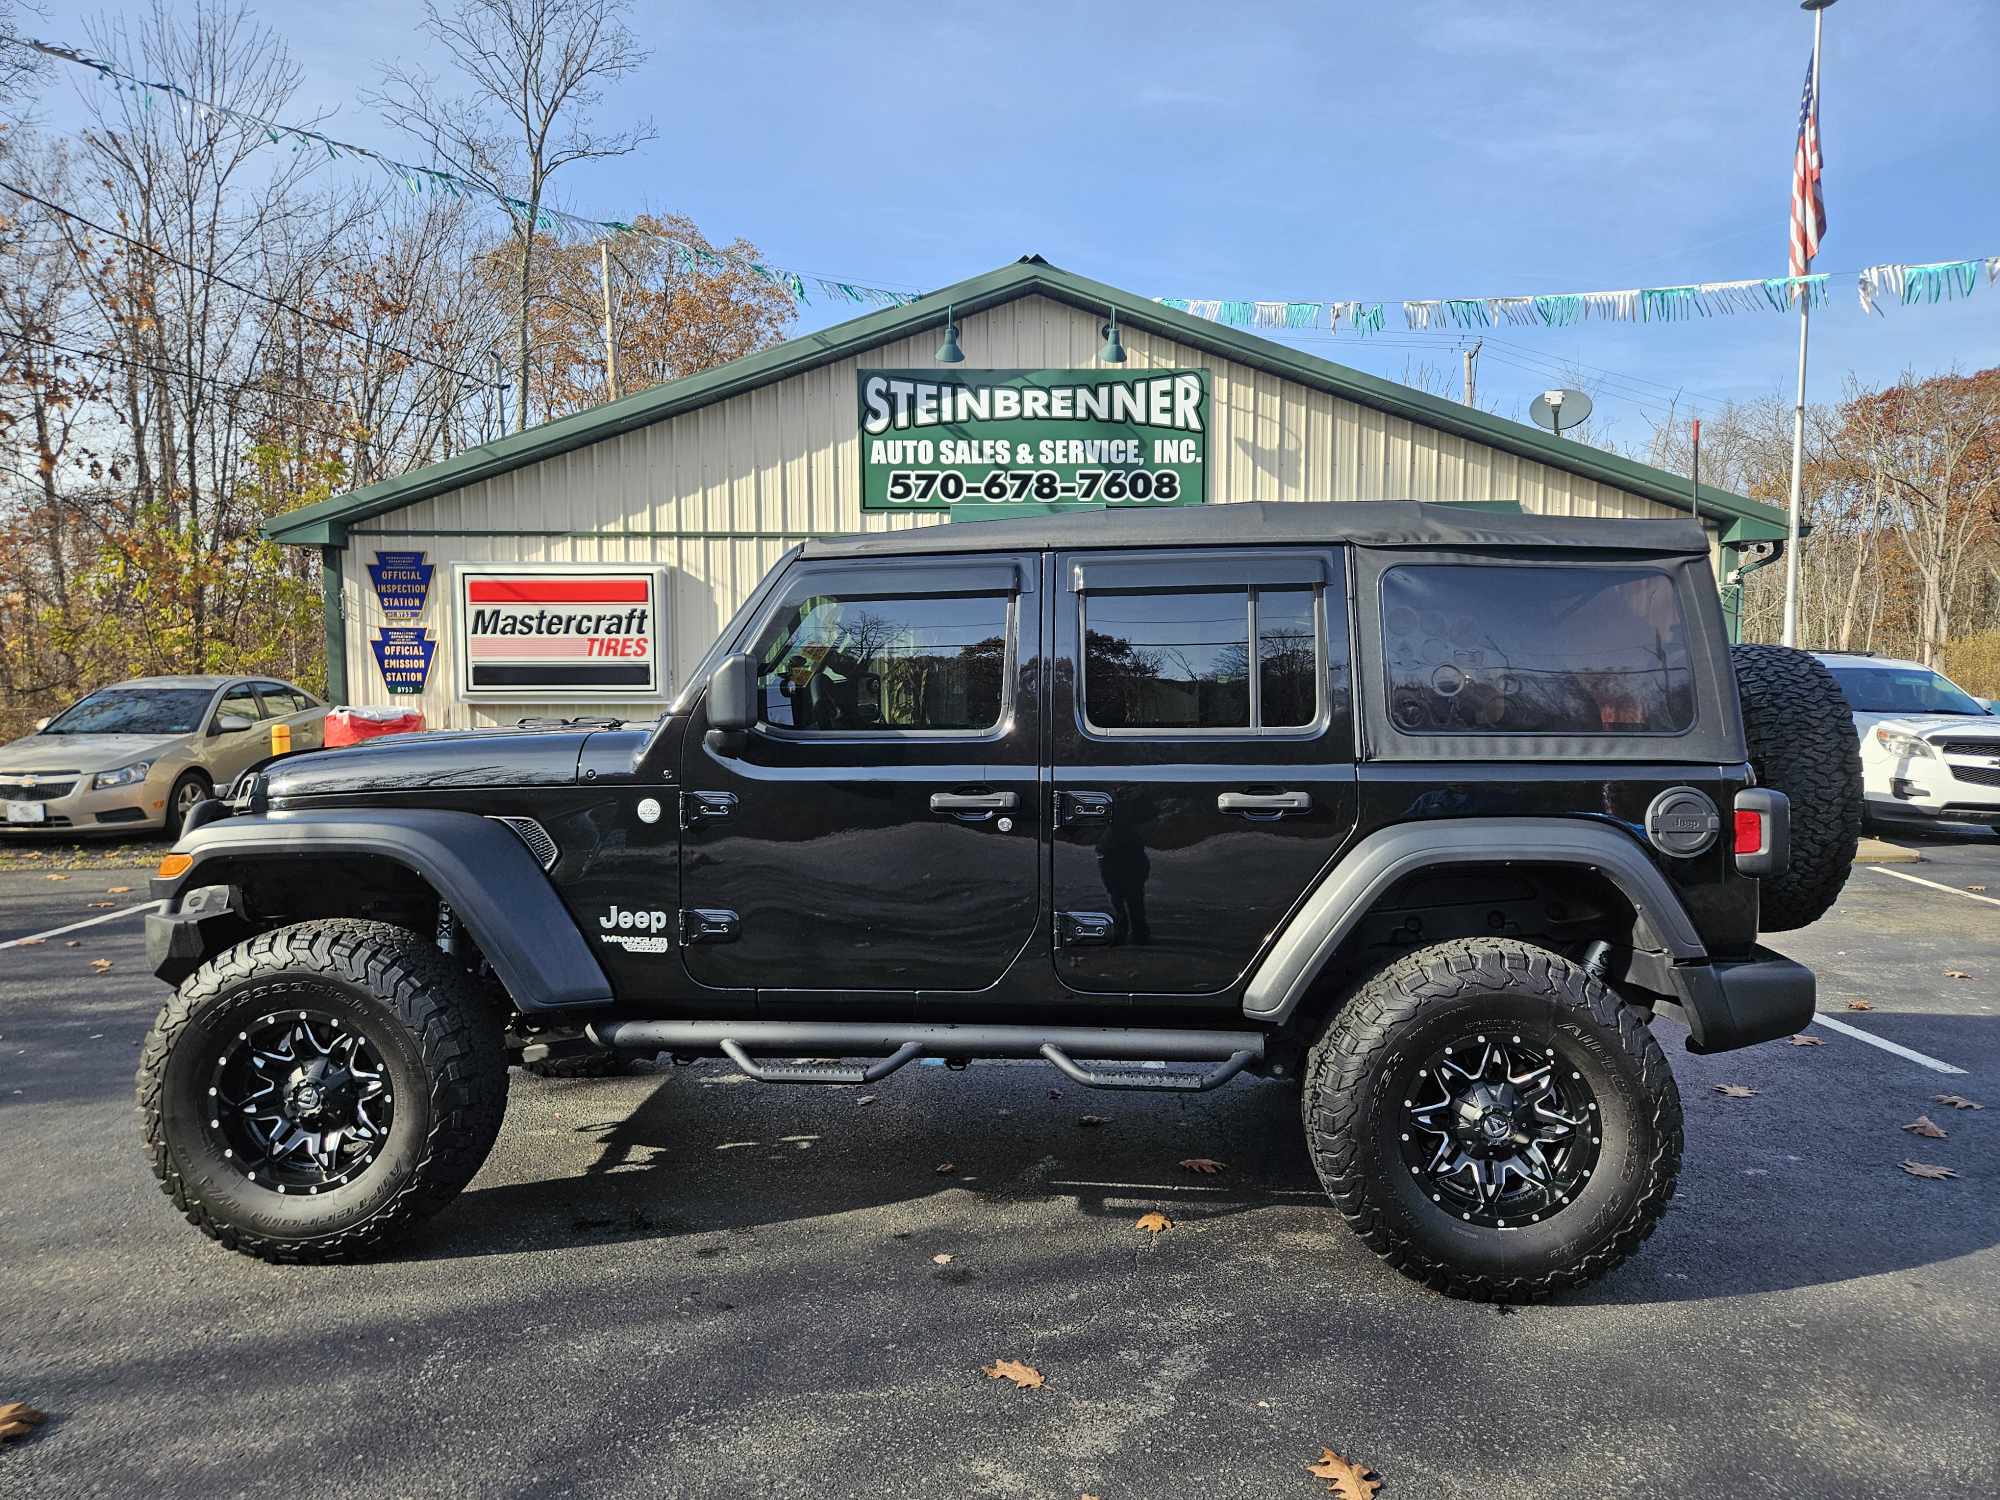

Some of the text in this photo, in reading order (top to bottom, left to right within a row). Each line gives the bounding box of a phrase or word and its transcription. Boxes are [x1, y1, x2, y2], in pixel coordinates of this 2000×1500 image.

[863, 373, 1202, 432] STEINBRENNER
[870, 439, 1202, 467] AUTO SALES & SERVICE, INC.
[887, 469, 1180, 503] 570-678-7608
[382, 570, 422, 580] OFFICIAL
[377, 584, 426, 593] INSPECTION
[383, 597, 420, 606] STATION
[471, 607, 648, 636] Mastercraft
[384, 645, 425, 656] OFFICIAL
[585, 637, 649, 657] TIRES
[384, 659, 425, 669] EMISSION
[386, 672, 422, 682] STATION
[600, 906, 667, 933] Jeep
